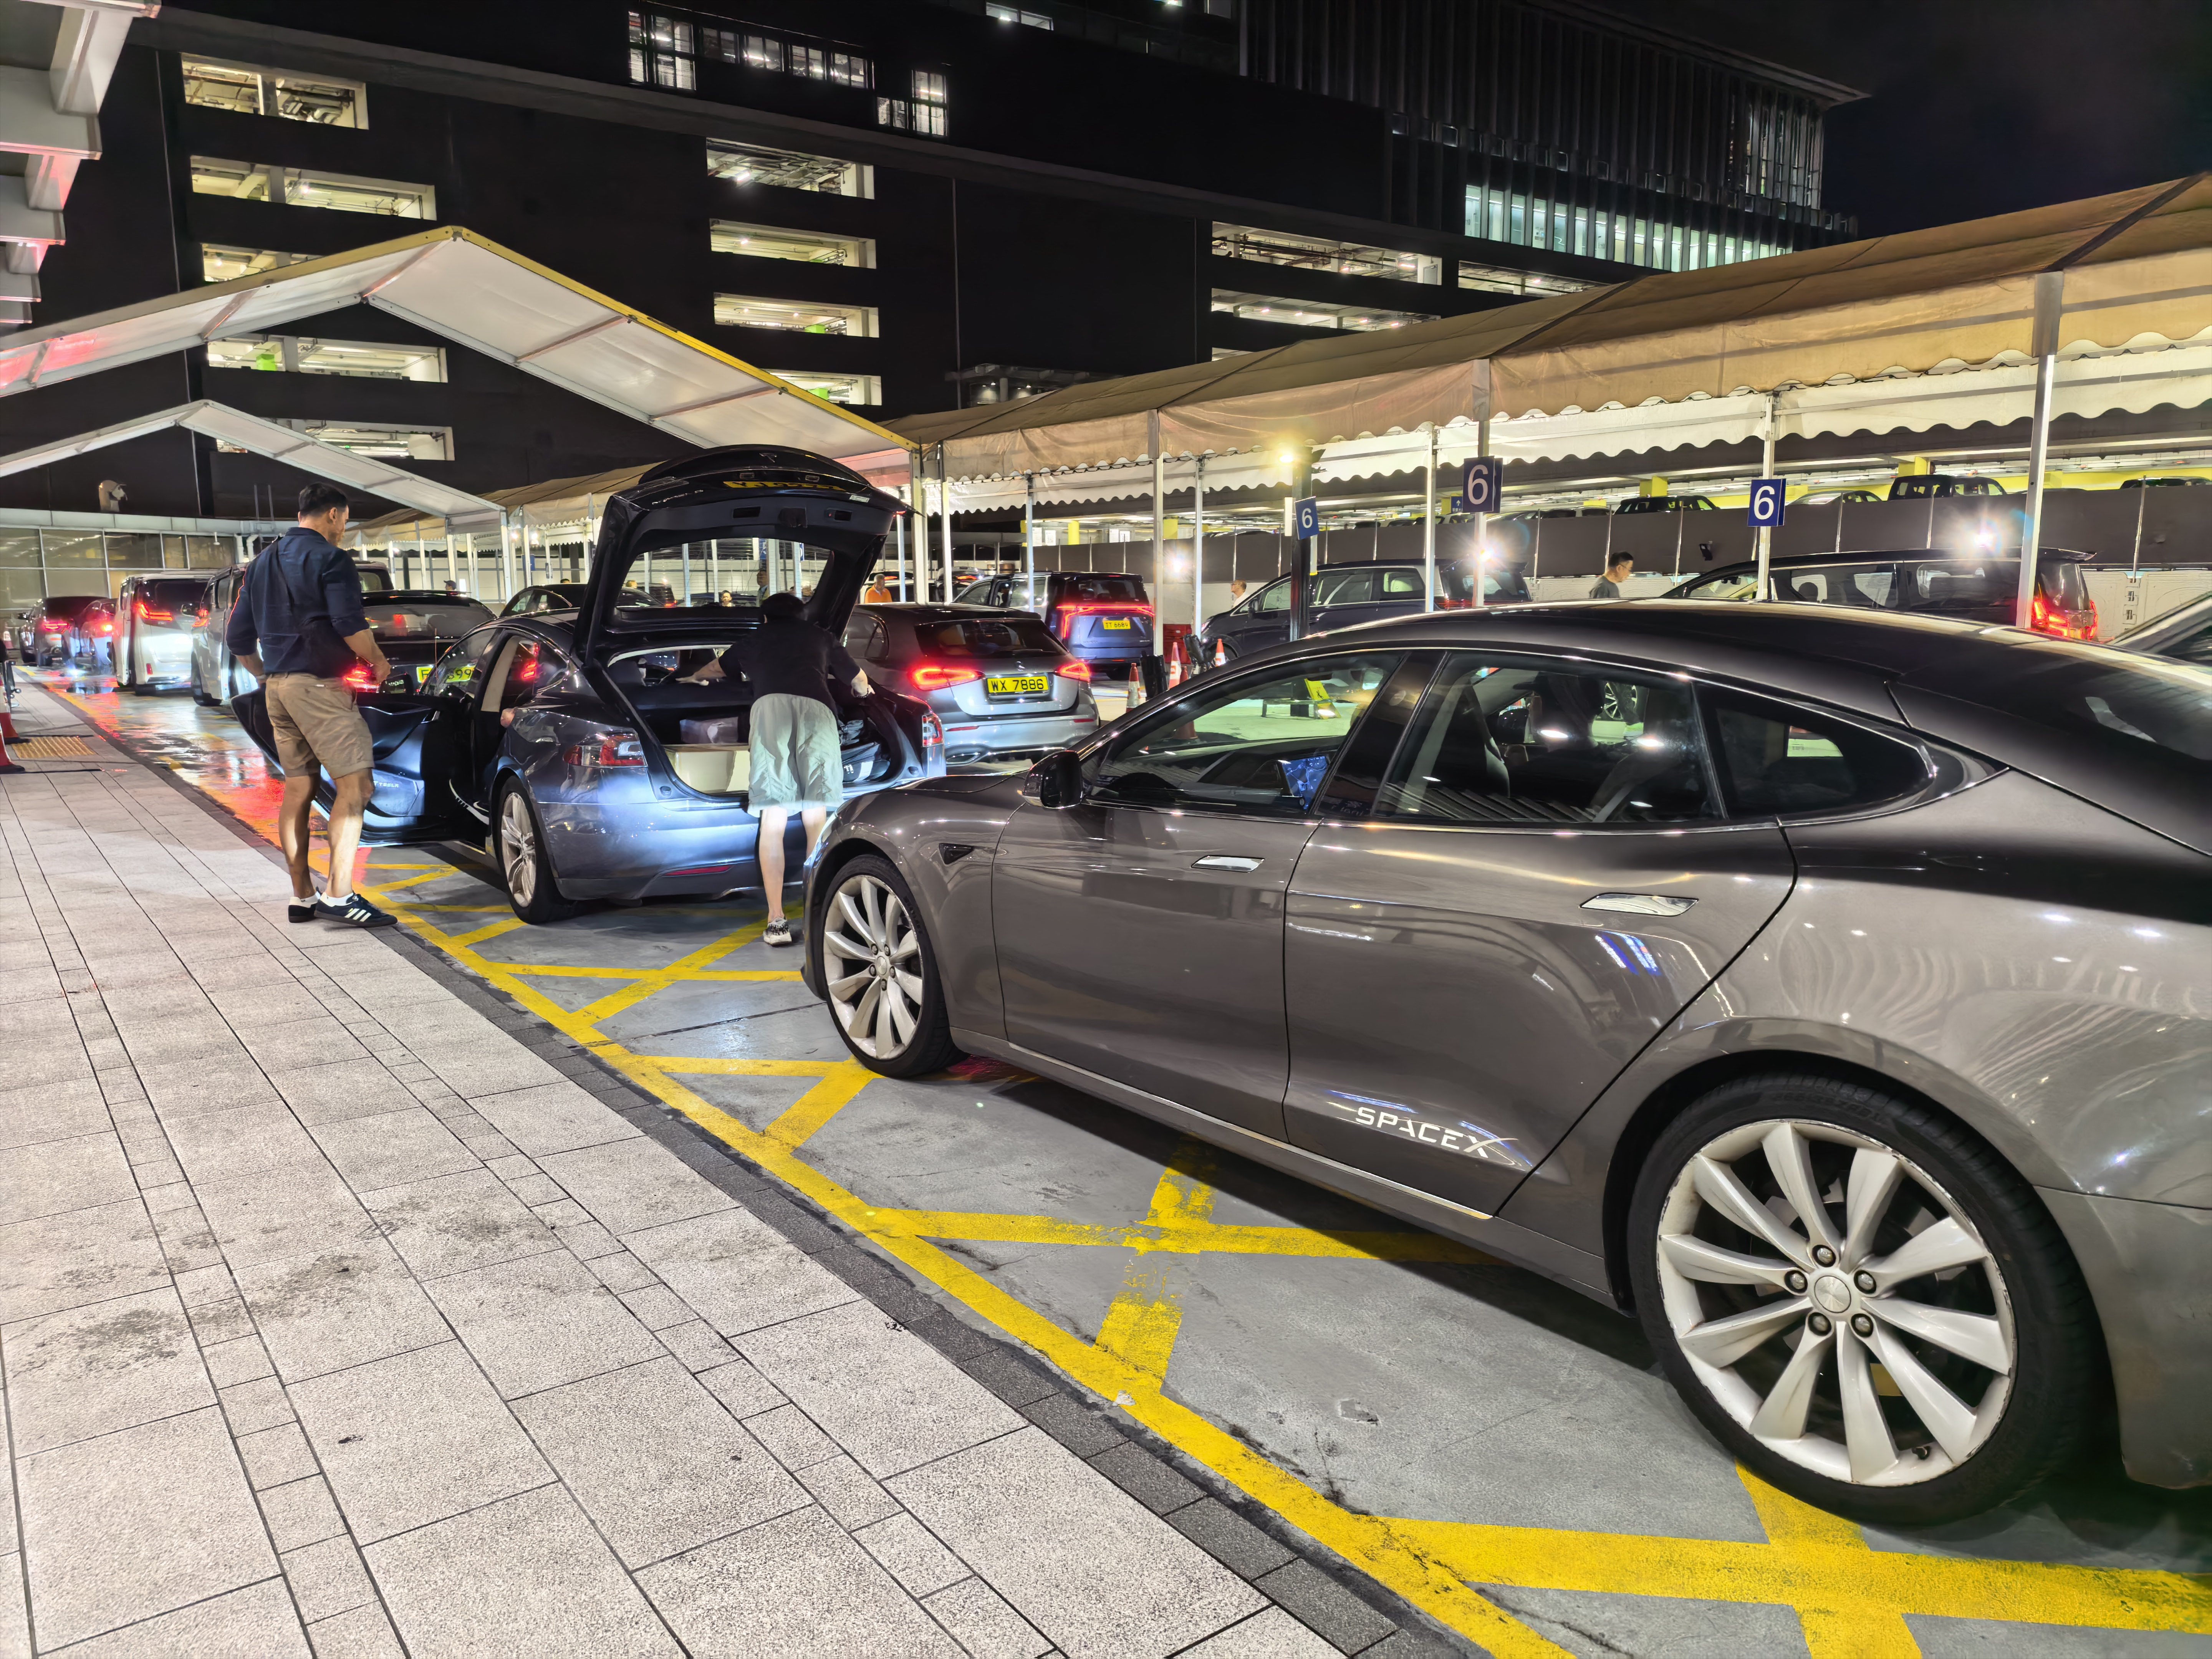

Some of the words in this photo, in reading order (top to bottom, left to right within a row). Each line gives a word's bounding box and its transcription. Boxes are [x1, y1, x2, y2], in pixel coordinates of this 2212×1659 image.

[1468, 464, 1488, 505] 6
[1302, 508, 1313, 528] 6
[1754, 485, 1775, 520] 6
[991, 680, 1007, 691] WX
[1012, 679, 1044, 690] 7886
[1356, 1106, 1519, 1158] SPACEX
